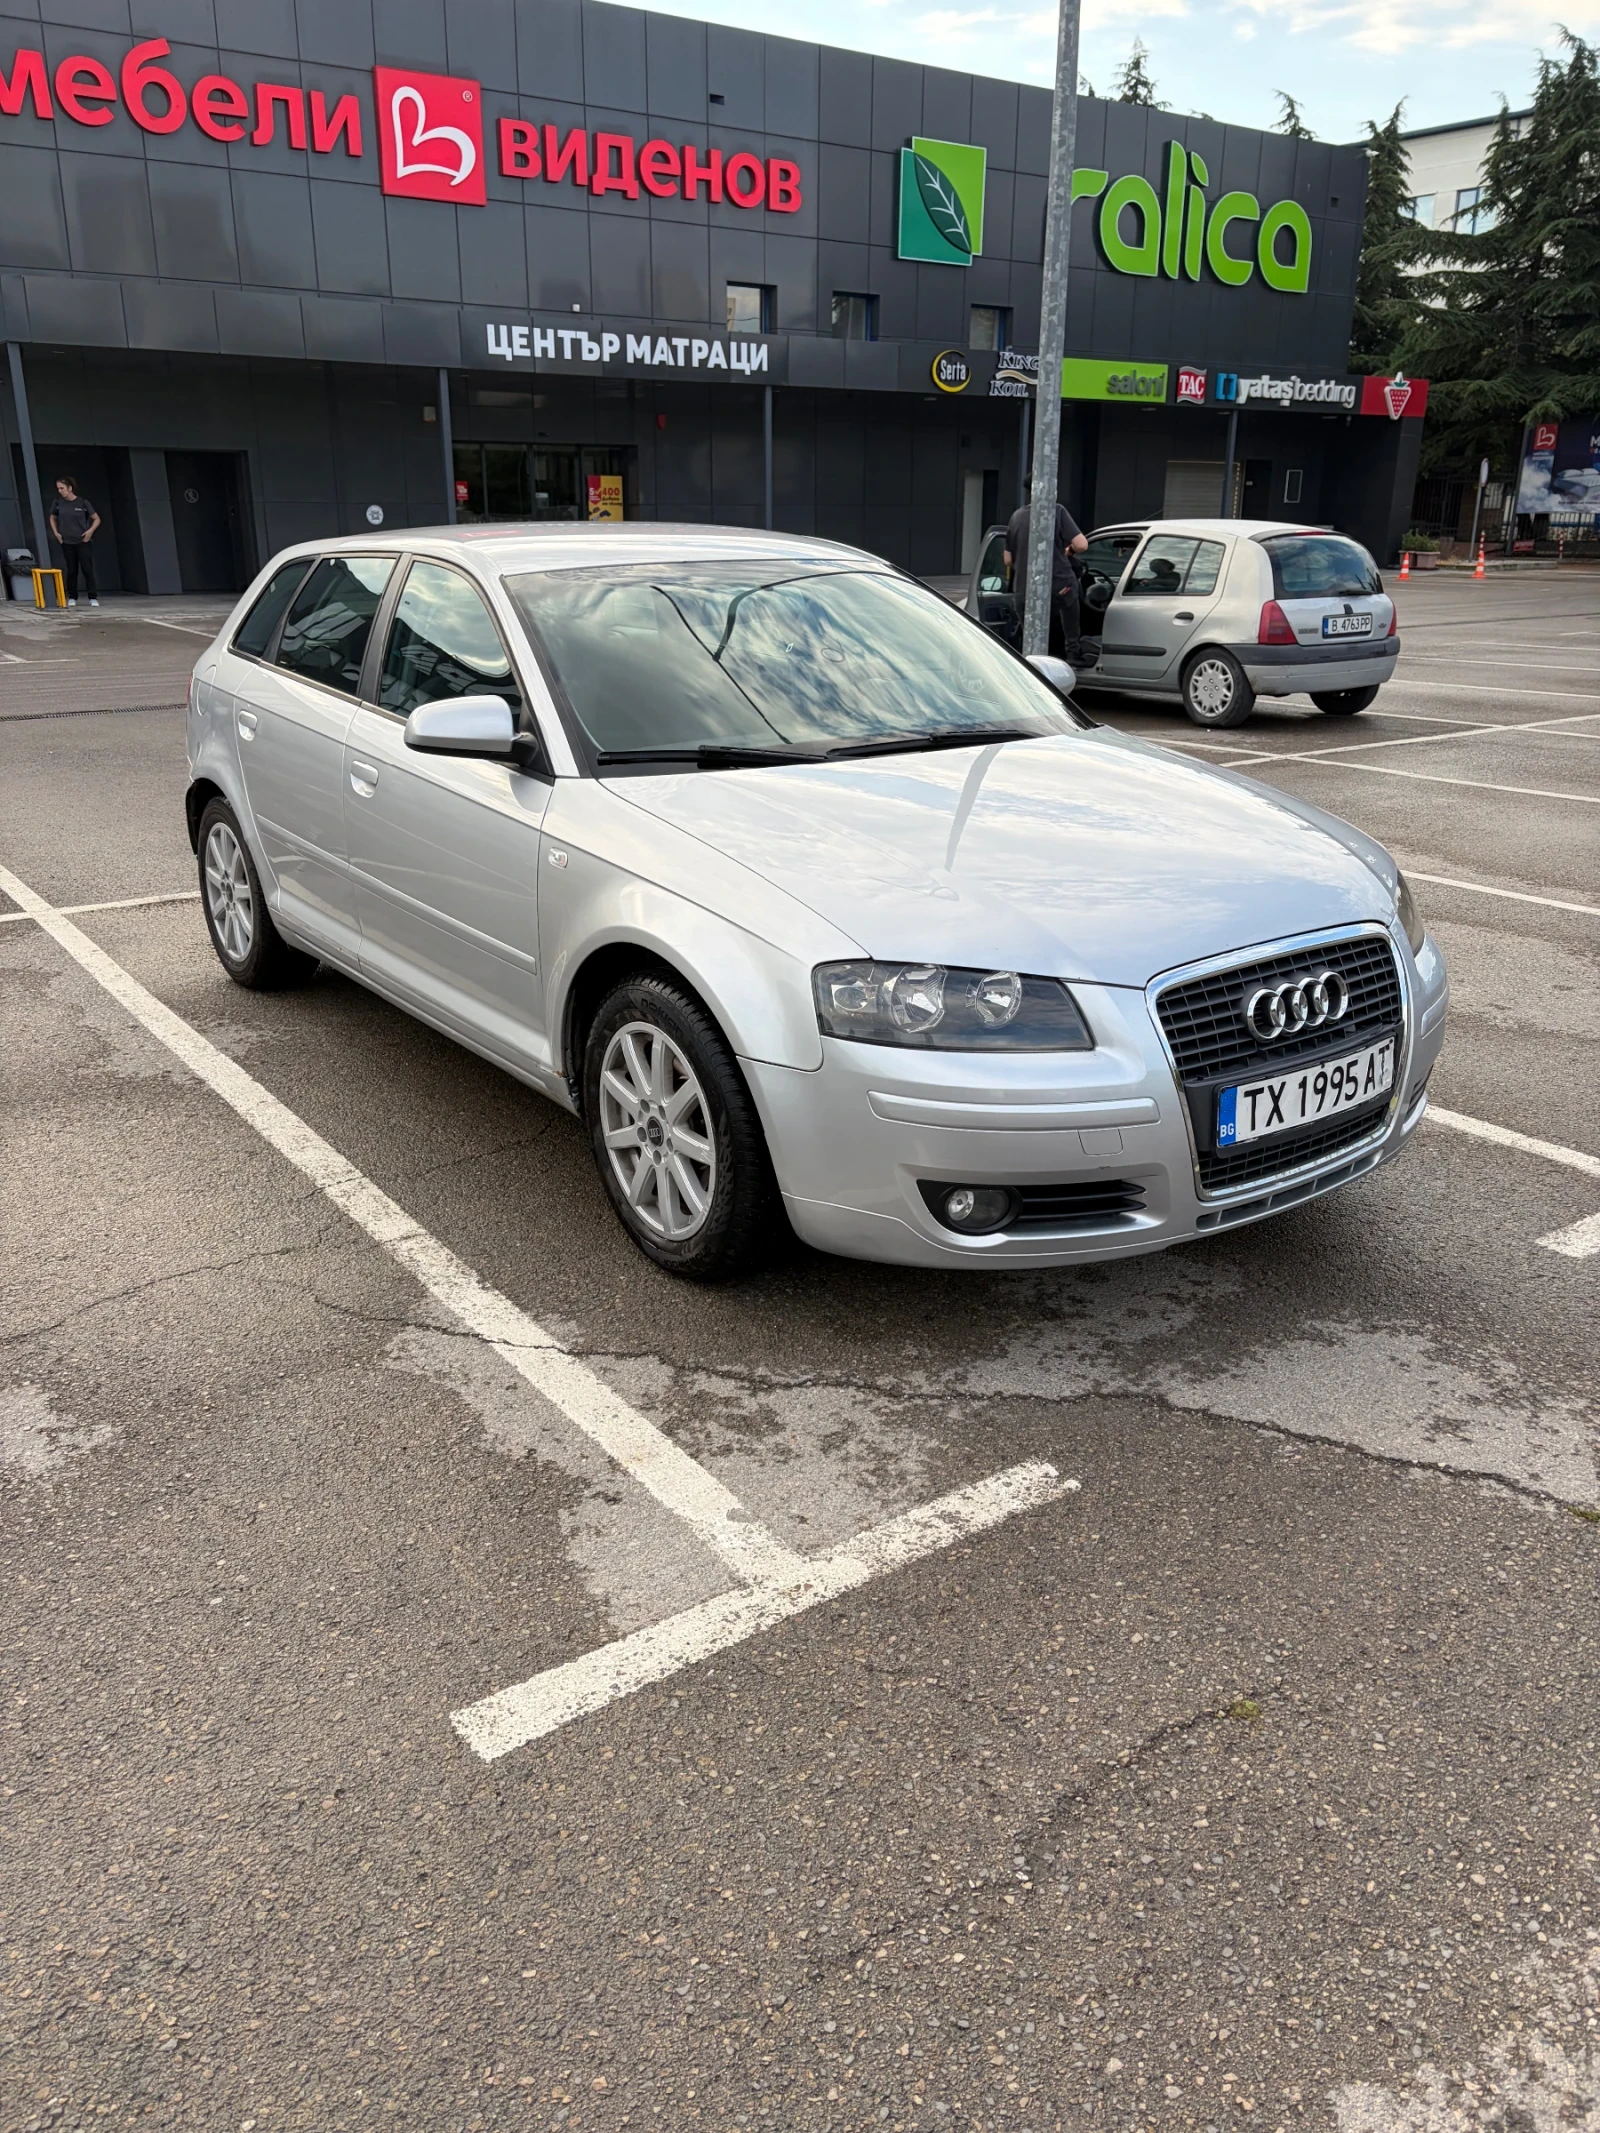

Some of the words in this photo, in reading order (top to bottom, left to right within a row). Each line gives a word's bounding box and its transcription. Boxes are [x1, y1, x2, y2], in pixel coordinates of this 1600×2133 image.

[0, 38, 363, 157] мебели
[497, 117, 803, 213] виденов
[486, 324, 621, 362] ЦЕНТЪР
[626, 333, 768, 376] МАТРАЦИ
[940, 359, 967, 381] Serta
[1107, 369, 1166, 397] saloni
[602, 487, 620, 496] 400
[1341, 618, 1360, 631] 4763
[1243, 1081, 1286, 1132] TX
[1298, 1061, 1359, 1117] 1995
[1220, 1124, 1235, 1138] BG
